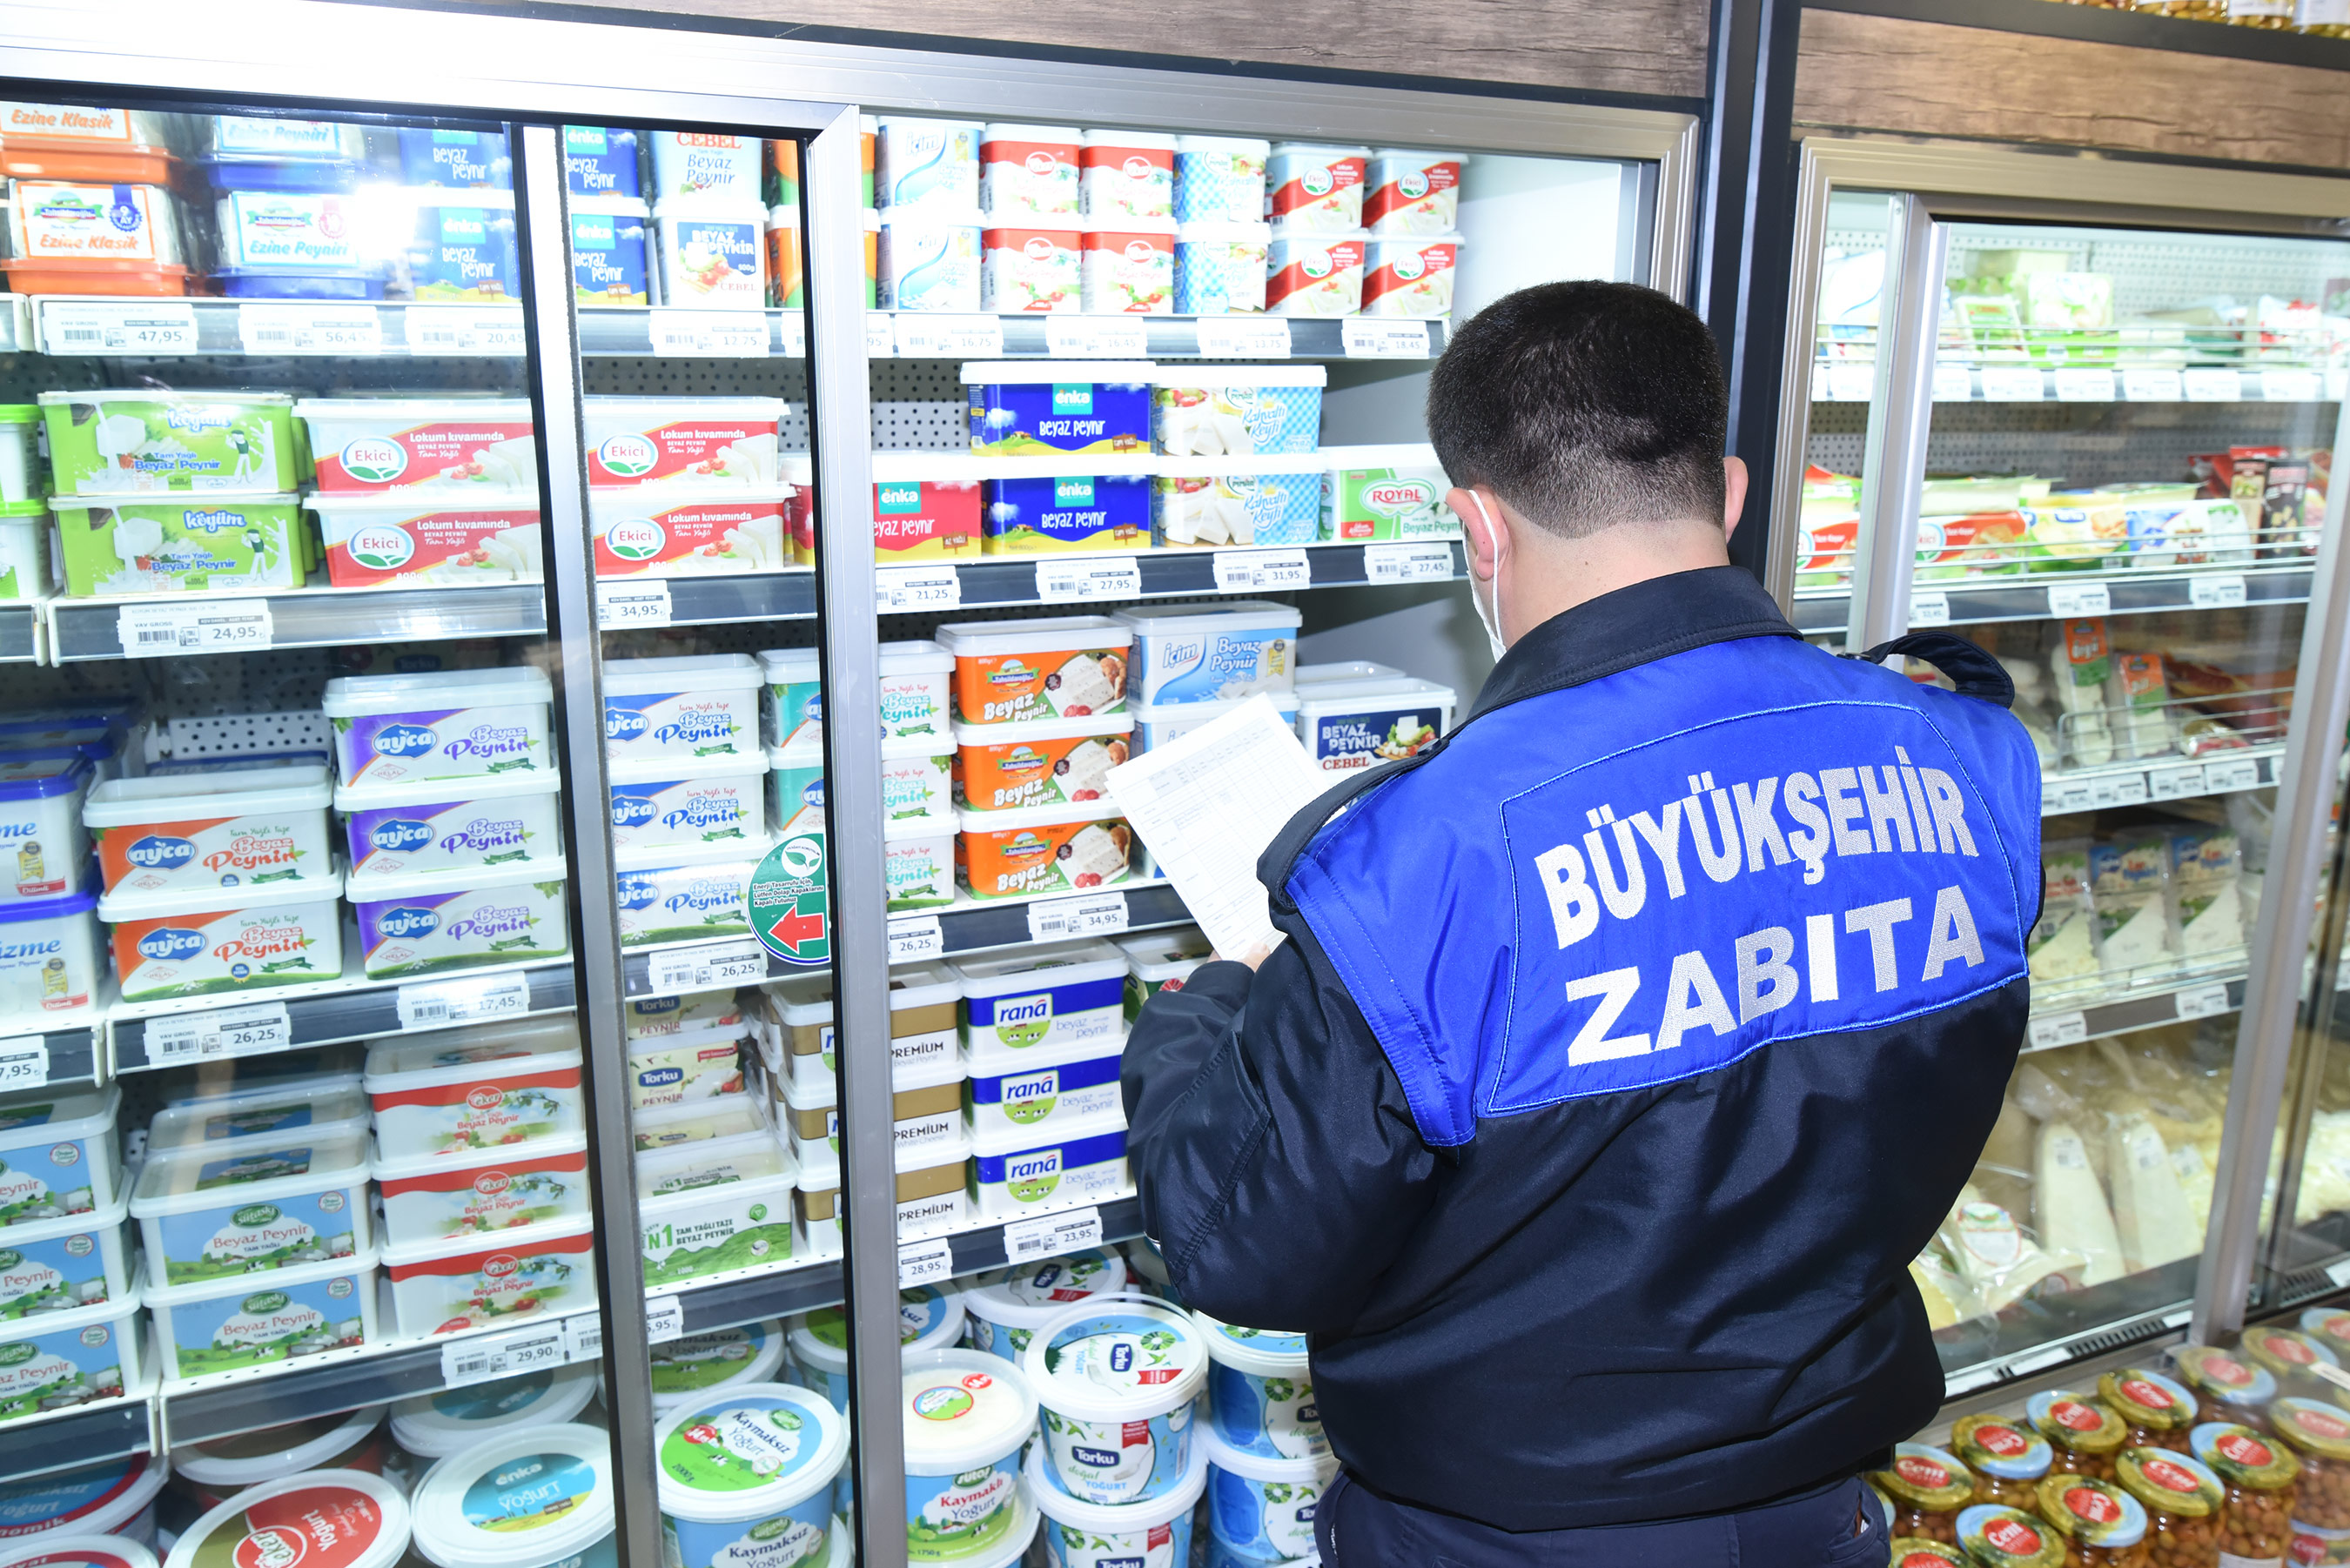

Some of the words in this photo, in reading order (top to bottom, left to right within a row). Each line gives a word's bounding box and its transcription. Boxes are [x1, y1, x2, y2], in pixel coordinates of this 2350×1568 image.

[11, 109, 57, 125] Ezine
[61, 111, 113, 129] Klasik
[687, 155, 732, 172] Beyaz
[686, 170, 735, 185] Peynir
[40, 233, 84, 249] Ezine
[88, 235, 138, 250] Klasik
[137, 330, 183, 343] 47,95
[410, 432, 446, 442] Lokum
[448, 432, 505, 441] kıvamında
[661, 430, 694, 439] Lokum
[695, 429, 746, 439] kıvamında
[176, 451, 196, 460] Yağlı
[355, 450, 392, 461] Ekici
[611, 446, 644, 457] Ekici
[135, 459, 175, 471] Beyaz
[180, 459, 220, 471] Peynir
[1373, 489, 1423, 504] ROYAL
[184, 509, 246, 533] köyüm
[417, 520, 453, 530] Lokum
[454, 519, 510, 529] kıvamında
[668, 513, 700, 523] Lokum
[702, 513, 752, 522] kıvamında
[619, 531, 652, 542] Ekici
[1403, 523, 1433, 534] Beyaz
[362, 538, 399, 549] Ekici
[192, 552, 212, 561] Yağlı
[151, 561, 191, 572] Beyaz
[196, 560, 236, 570] Peynir
[1419, 563, 1444, 573] 27,45
[1272, 571, 1300, 580] 31,95
[1100, 580, 1130, 591] 27,95
[916, 589, 949, 600] 21,25
[621, 605, 659, 618] 34,95
[212, 626, 257, 640] 24,95
[1218, 638, 1261, 653] Beyaz
[1163, 640, 1199, 669] İçim
[1210, 654, 1257, 672] Peynir
[883, 694, 930, 709] Beyaz
[984, 693, 1035, 720] Beyaz
[679, 711, 731, 727] Beyaz
[1014, 703, 1048, 722] Peynir
[470, 725, 527, 744] Beyaz
[655, 724, 731, 745] Peynir
[1322, 723, 1366, 740] BEYAZ
[444, 740, 530, 760] Peynir
[1328, 731, 1381, 752] PEYNİR
[1322, 757, 1370, 770] CEBEL
[883, 777, 925, 794] Beyaz
[994, 779, 1044, 807] Beyaz
[687, 796, 738, 813] Beyaz
[1023, 787, 1057, 807] Peynir
[467, 819, 522, 836] Beyaz
[662, 809, 739, 829] Peynir
[231, 836, 293, 855] Beyaz
[440, 833, 525, 854] Peynir
[1535, 745, 1979, 949] BÜYÜKŞEHİR
[203, 850, 296, 872] Peynir
[887, 856, 932, 873] Beyaz
[997, 863, 1047, 891] Beyaz
[1026, 872, 1060, 893] Peynir
[689, 880, 742, 896] Beyaz
[754, 890, 773, 899] Lütfen
[791, 886, 823, 895] Kapaklarını
[665, 893, 742, 913] Peynir
[473, 906, 529, 923] Beyaz
[1088, 914, 1119, 925] 34,95
[241, 926, 303, 945] Beyaz
[447, 919, 531, 940] Peynir
[213, 940, 306, 962] Peynir
[900, 939, 931, 952] 26,25
[722, 963, 755, 976] 26,25
[1566, 885, 1985, 1068] ZABITA
[640, 998, 675, 1011] Torku
[640, 1021, 681, 1035] PEYNİR
[1056, 1019, 1087, 1033] beyaz
[1076, 1023, 1109, 1040] peynir
[234, 1029, 275, 1044] 26,25
[642, 1071, 679, 1085] Torku
[642, 1092, 682, 1106] PEYNİR
[1062, 1093, 1093, 1108] beyaz
[1081, 1099, 1113, 1115] peynir
[457, 1119, 487, 1130] Beyaz
[488, 1113, 520, 1125] Peynir
[894, 1122, 949, 1141] PREMİUM
[1065, 1170, 1097, 1185] beyaz
[1084, 1175, 1116, 1192] peynir
[465, 1203, 494, 1216] Beyaz
[495, 1197, 527, 1210] Peynir
[899, 1202, 954, 1222] PREMİUM
[675, 1228, 693, 1237] TAM
[694, 1222, 716, 1234] YAĞLI
[716, 1219, 734, 1230] TAZE
[675, 1232, 702, 1245] BEYAZ
[703, 1226, 735, 1240] PEYNİR
[1064, 1229, 1092, 1243] 23,95
[212, 1234, 258, 1250] Beyaz
[262, 1225, 308, 1241] Peynir
[910, 1261, 941, 1276] 28,95
[3, 1269, 55, 1288] Peynir
[473, 1286, 503, 1297] Beyaz
[504, 1279, 534, 1292] Peynir
[223, 1321, 267, 1337] Beyaz
[272, 1311, 317, 1327] Peynir
[517, 1346, 554, 1362] 29,90
[1114, 1345, 1130, 1371] Torku
[19, 1361, 70, 1379] Peynir
[2134, 1380, 2171, 1407] Cem
[2057, 1404, 2086, 1426] Cem
[732, 1411, 791, 1454] Kaymaksız
[728, 1427, 766, 1457] Yoğurt
[2222, 1437, 2253, 1460] Cem
[1076, 1451, 1116, 1465] Torku
[1897, 1459, 1946, 1478] Cem
[2150, 1460, 2197, 1489] Cem
[940, 1478, 1004, 1509] Kaymaklı
[1086, 1480, 1127, 1491] YOĞURT
[951, 1496, 997, 1521] Yoğurt
[728, 1525, 809, 1559] Kaymaksız
[1987, 1522, 2024, 1547] Cem
